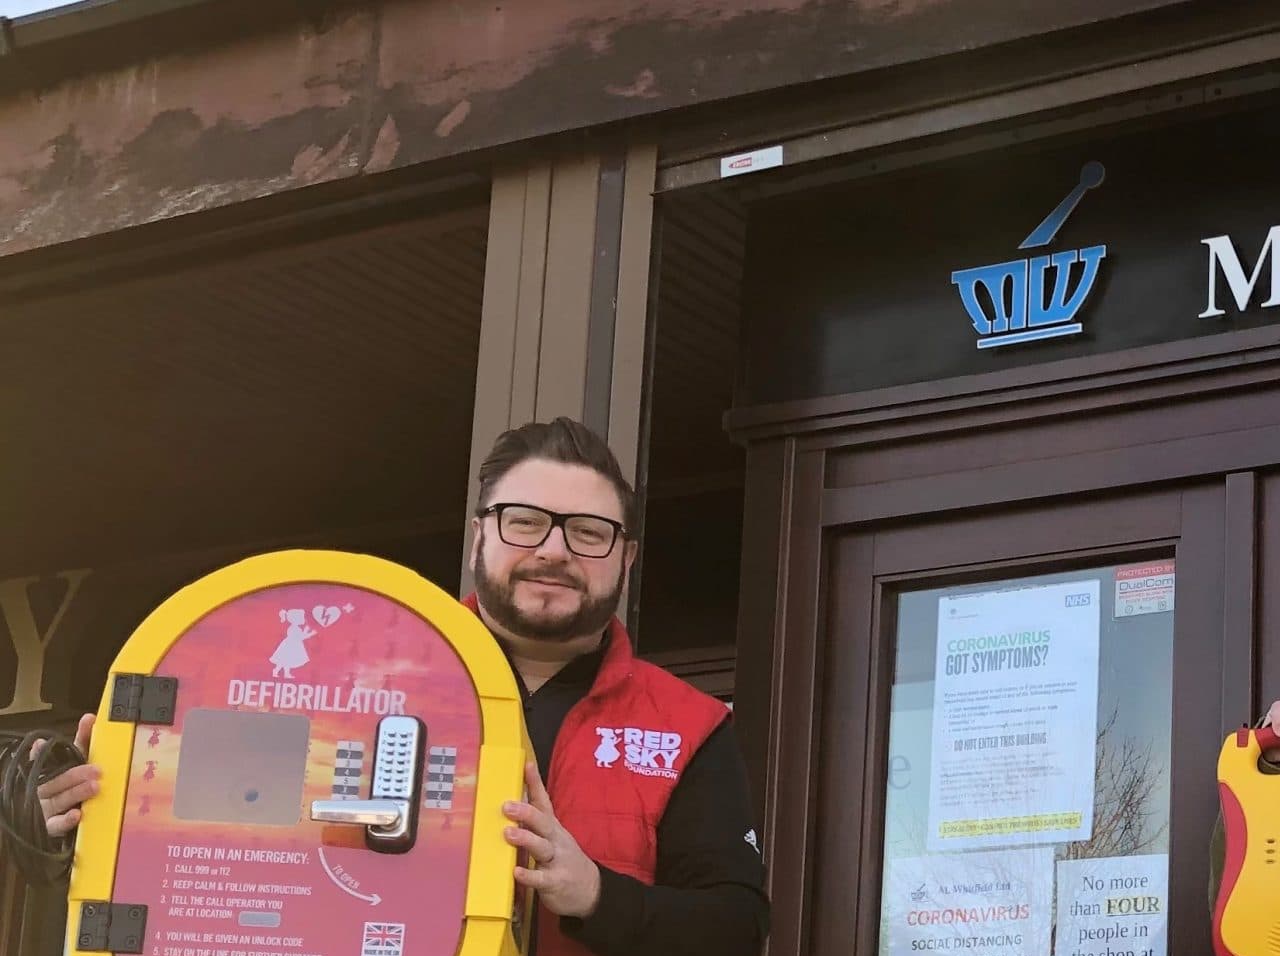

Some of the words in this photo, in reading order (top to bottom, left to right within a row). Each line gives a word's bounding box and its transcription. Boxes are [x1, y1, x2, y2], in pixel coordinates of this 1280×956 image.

[1066, 594, 1090, 608] NHS
[947, 630, 1051, 653] CORONAVIRUS
[946, 654, 970, 676] GOT
[972, 645, 1049, 674] SYMPTOMS?
[228, 679, 406, 716] DEFIBRILLATOR
[624, 728, 682, 750] RED
[979, 736, 999, 749] ENTER
[1000, 735, 1016, 748] THIS
[625, 745, 680, 769] SKY
[624, 760, 678, 780] FOUNDATION
[168, 846, 180, 858] TO
[183, 846, 211, 859] OPEN
[214, 848, 225, 860] IN
[228, 850, 241, 861] AN
[245, 851, 310, 864] EMERGENCY:
[175, 865, 193, 873] CALL
[195, 866, 209, 875] 999
[220, 867, 231, 876] 112
[173, 880, 193, 890] KEEP
[195, 882, 216, 891] CALM
[225, 883, 256, 892] FOLLOW
[258, 885, 312, 896] INSTRUCTIONS
[1083, 876, 1104, 892] No
[1110, 876, 1149, 889] more
[172, 896, 188, 904] TELL
[191, 897, 201, 905] THE
[202, 898, 224, 907] CALL
[226, 899, 265, 909] OPERATOR
[268, 901, 283, 909] YOU
[1071, 901, 1101, 916] than
[1107, 897, 1161, 914] FOUR
[169, 908, 185, 916] ARE
[196, 909, 232, 919] LOCATION
[907, 904, 1030, 926] CORONAVIRUS
[167, 932, 181, 941] YOU
[184, 934, 200, 942] WILL
[203, 934, 214, 943] BE
[215, 935, 238, 944] GIVEN
[240, 936, 250, 945] AN
[252, 937, 282, 946] UNLOCK
[283, 938, 304, 947] CODE
[1079, 922, 1129, 944] people
[1134, 923, 1148, 938] in
[912, 938, 950, 951] SOCIAL
[954, 934, 1022, 949] DISTANCING
